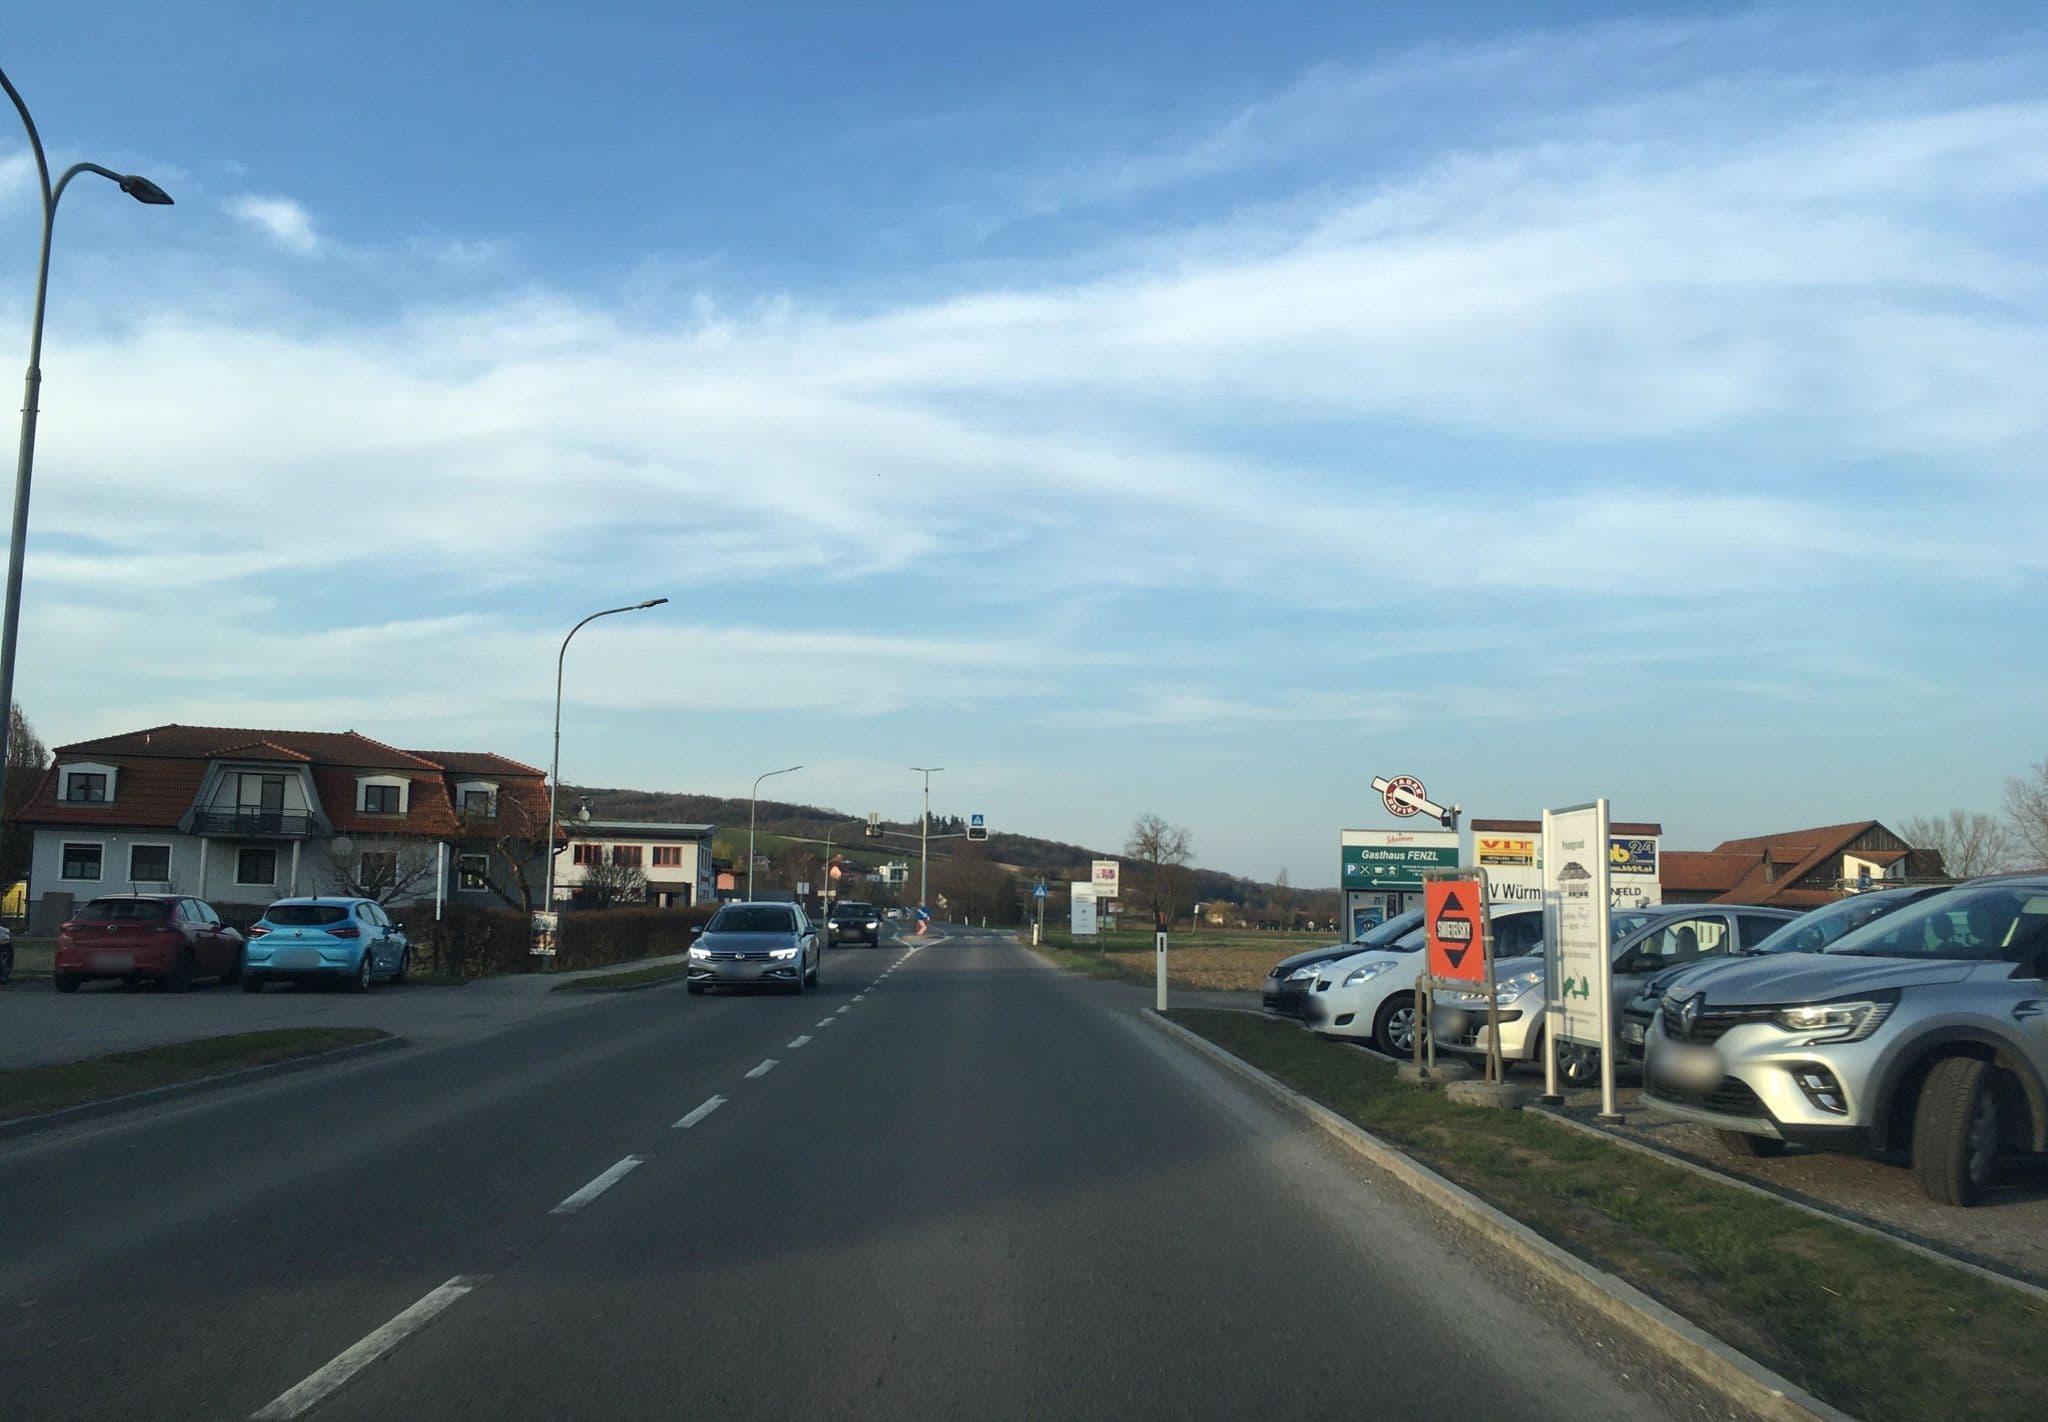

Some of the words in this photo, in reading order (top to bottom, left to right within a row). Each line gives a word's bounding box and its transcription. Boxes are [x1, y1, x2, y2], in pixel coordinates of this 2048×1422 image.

[1393, 779, 1422, 796] TABAK
[1386, 792, 1414, 814] TRAFIK
[1481, 840, 1533, 850] VIT
[1629, 841, 1655, 854] 24
[1361, 850, 1406, 861] Gasthaus
[1407, 851, 1439, 861] FENZL
